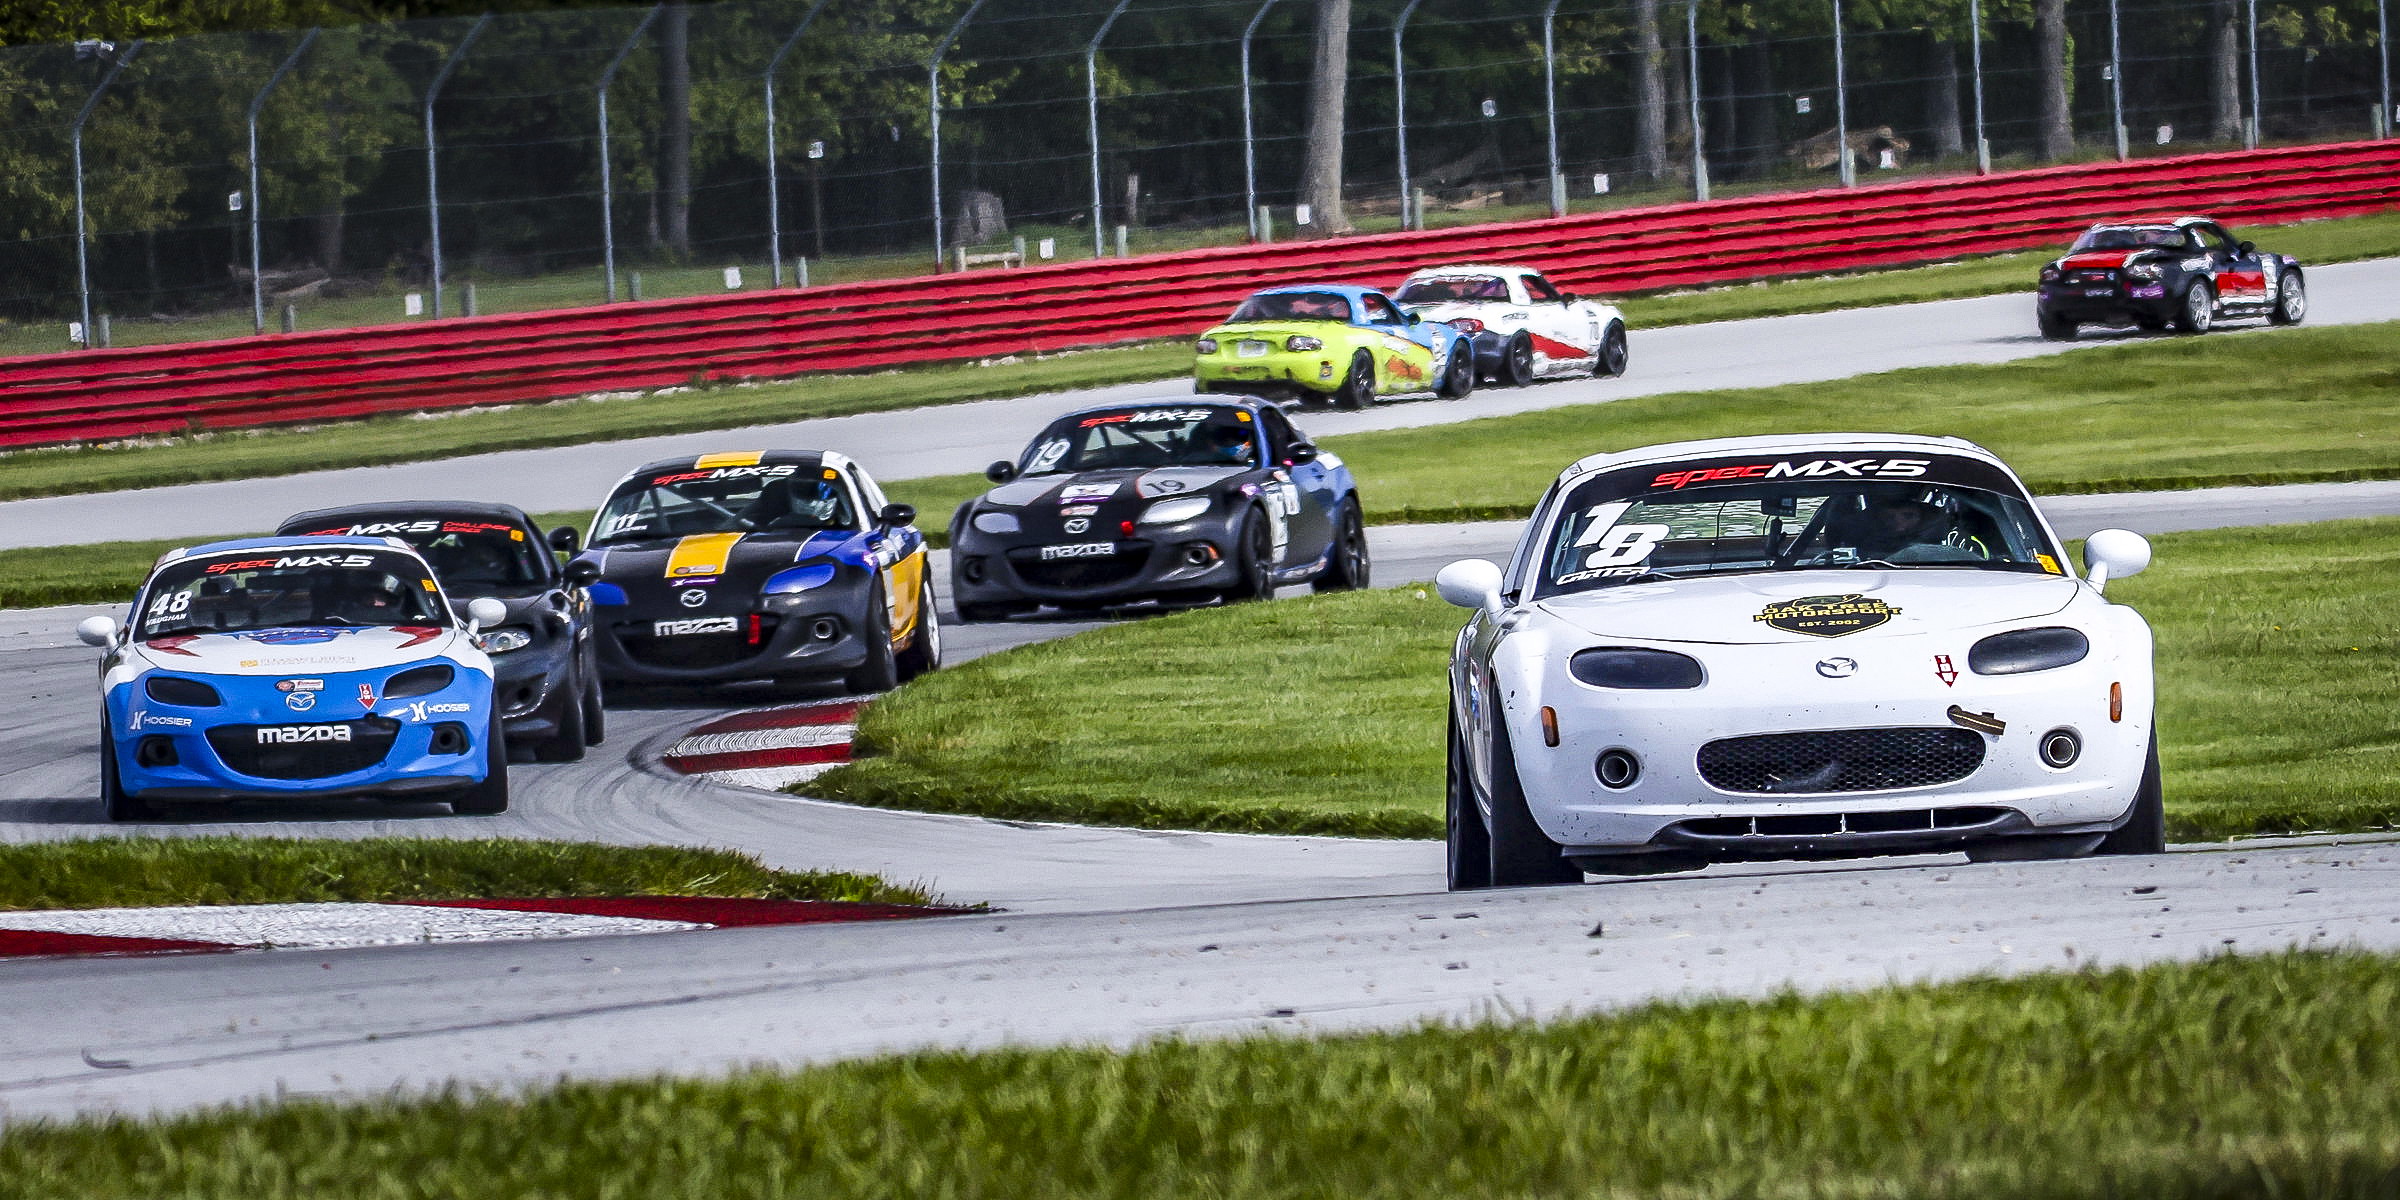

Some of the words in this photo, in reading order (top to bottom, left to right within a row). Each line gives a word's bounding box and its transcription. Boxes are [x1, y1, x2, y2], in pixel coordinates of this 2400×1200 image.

[1026, 439, 1071, 470] 19
[1145, 479, 1185, 494] 19
[1556, 565, 1651, 586] CARTER
[148, 590, 193, 616] 48
[1763, 604, 1814, 615] OAK
[1825, 601, 1888, 611] TREE
[145, 612, 188, 627] VAUGHAN
[1753, 607, 1904, 622] MOTORSPORT
[1798, 620, 1825, 628] EST.
[1828, 619, 1861, 627] 2002
[427, 703, 471, 714] HOOSIER
[143, 716, 193, 728] HOOSIER
